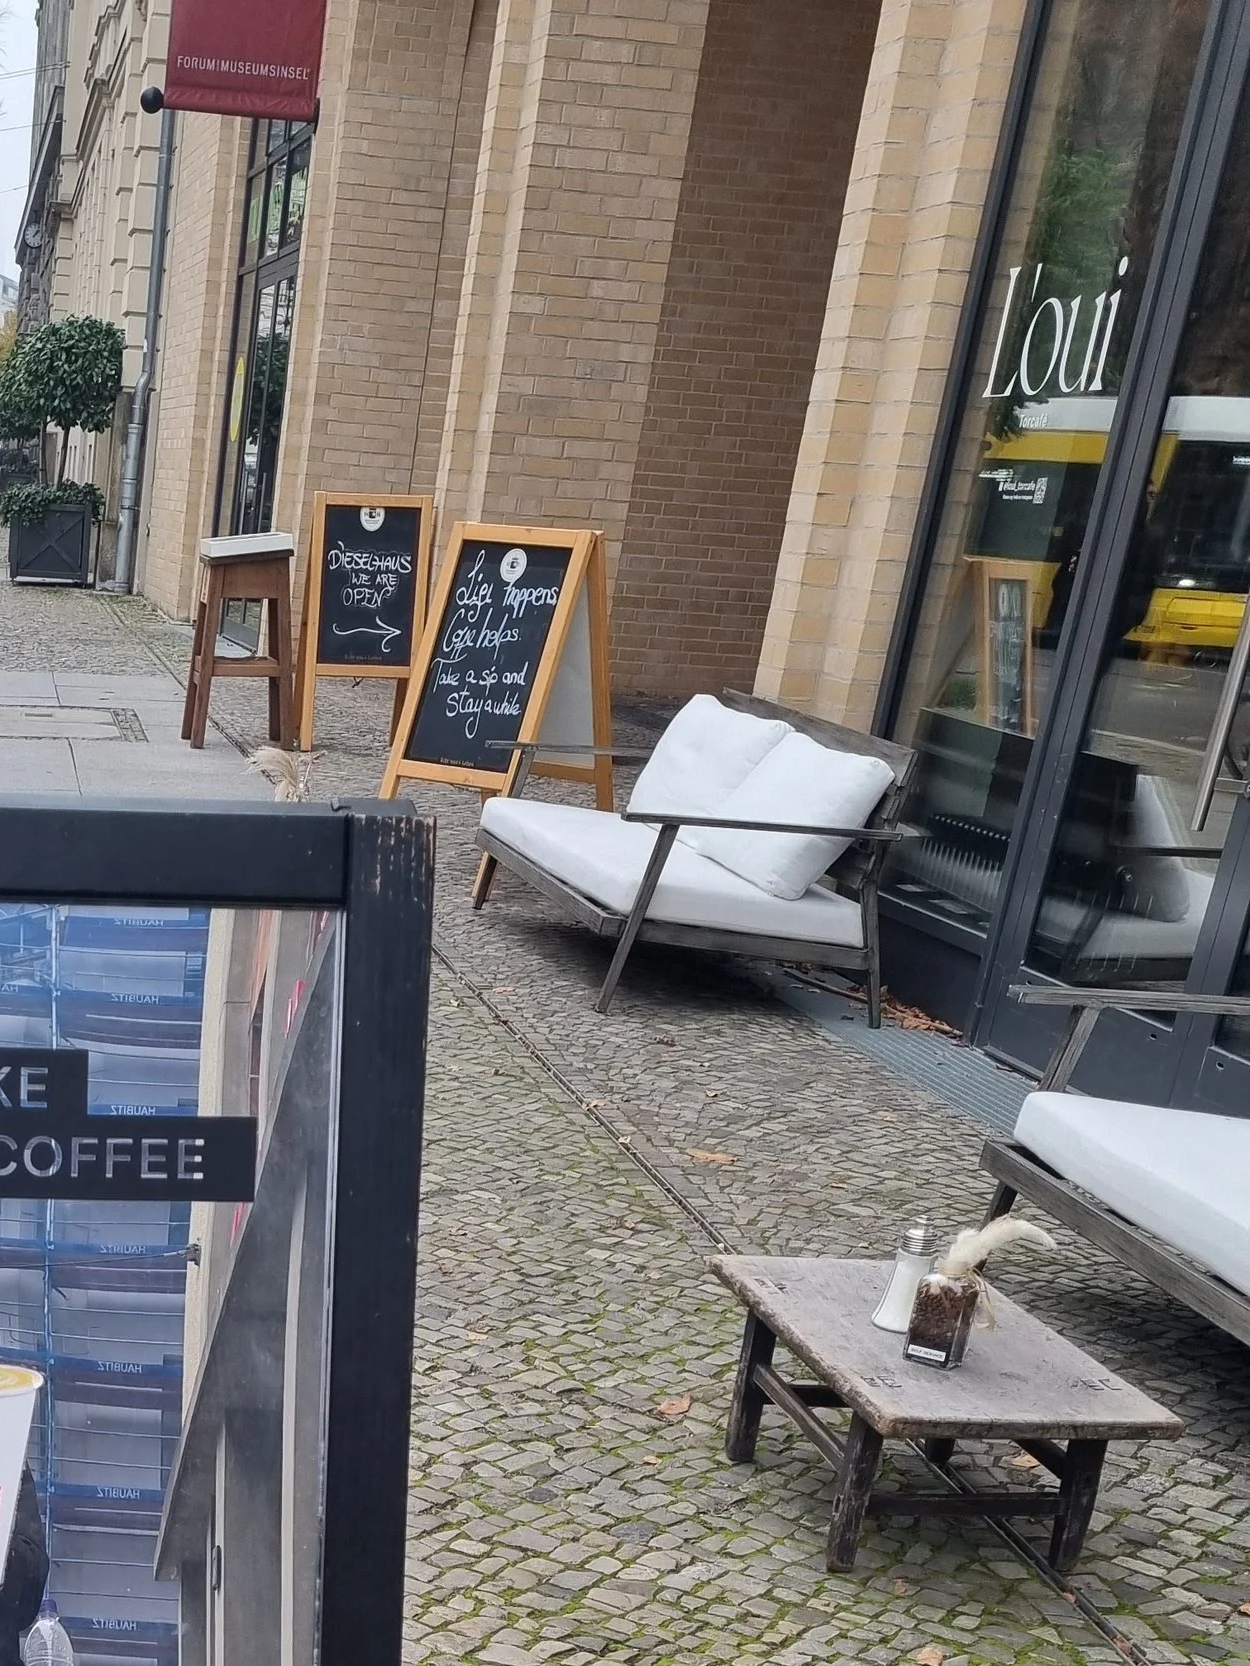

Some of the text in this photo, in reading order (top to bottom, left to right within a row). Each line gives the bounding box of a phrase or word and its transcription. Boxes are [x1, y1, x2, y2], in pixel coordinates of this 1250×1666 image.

[177, 55, 215, 71] FORUM
[220, 60, 309, 80] MUSEUMSINSEL
[982, 256, 1128, 398] L'oui
[343, 587, 391, 607] OPEN
[351, 573, 398, 589] WE ARE
[430, 653, 468, 693] Take
[465, 669, 478, 683] a
[502, 660, 529, 686] and
[446, 684, 484, 739] Stay
